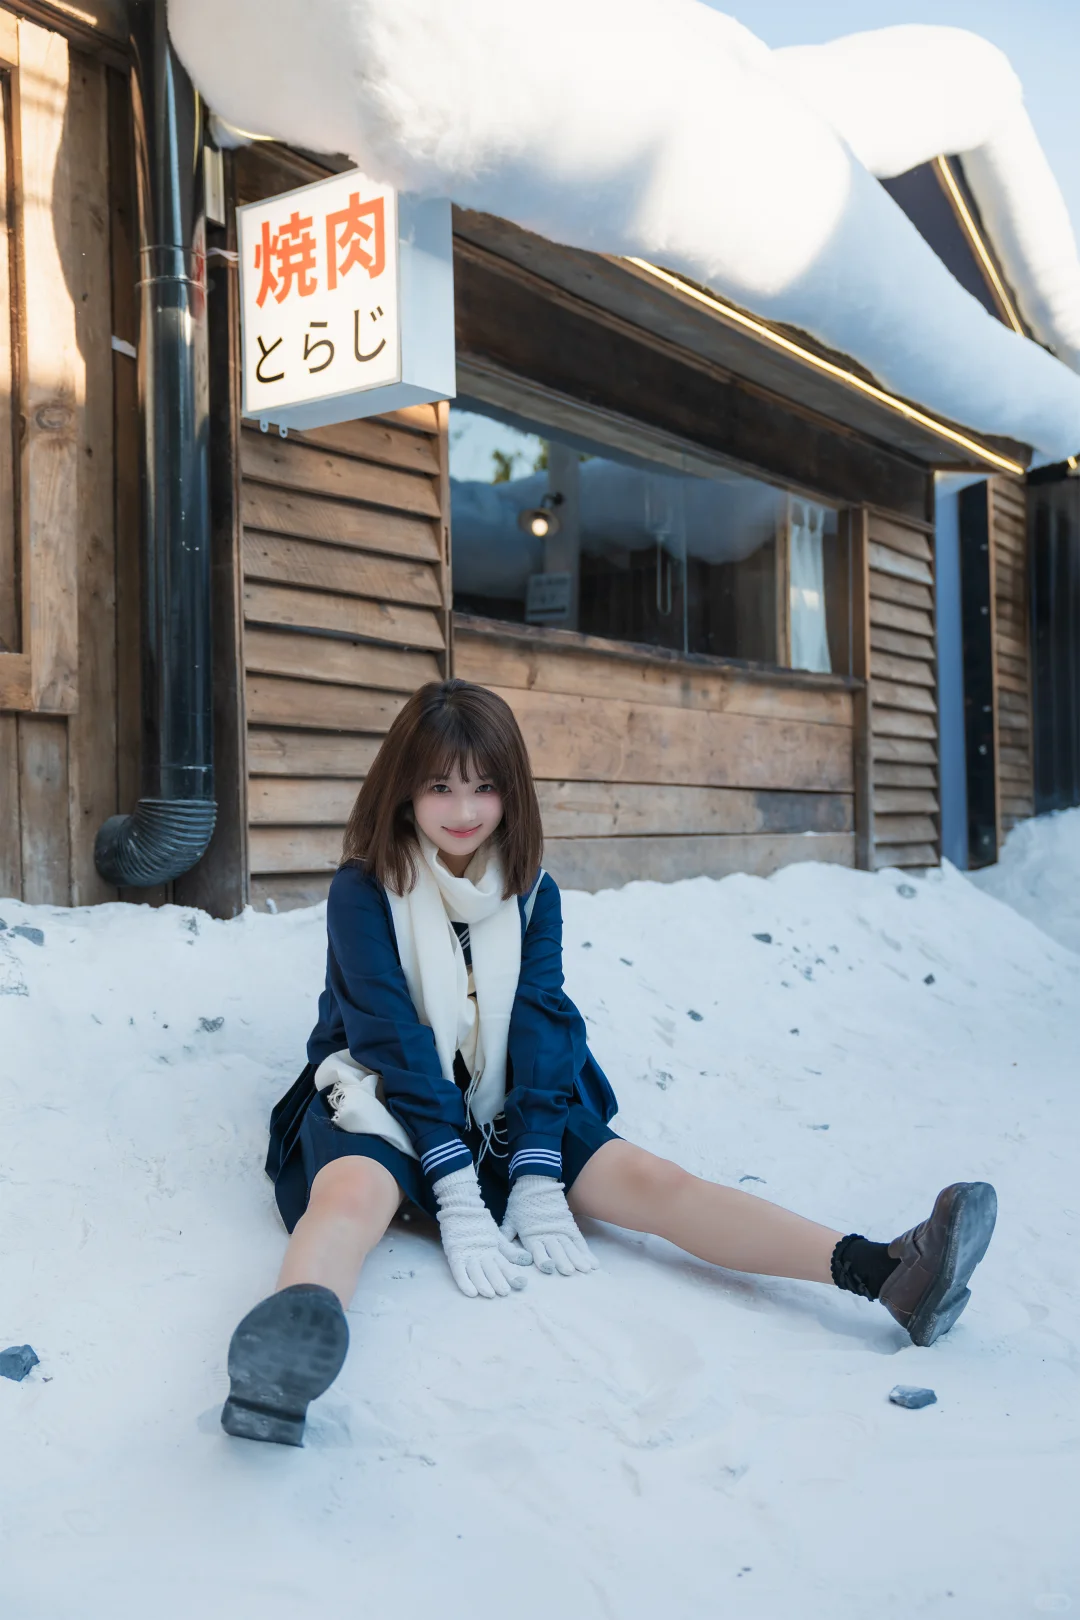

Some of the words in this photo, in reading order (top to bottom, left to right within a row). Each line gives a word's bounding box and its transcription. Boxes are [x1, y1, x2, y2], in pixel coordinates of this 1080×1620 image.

[254, 192, 386, 308] 焼肉
[255, 306, 386, 383] とらじ
